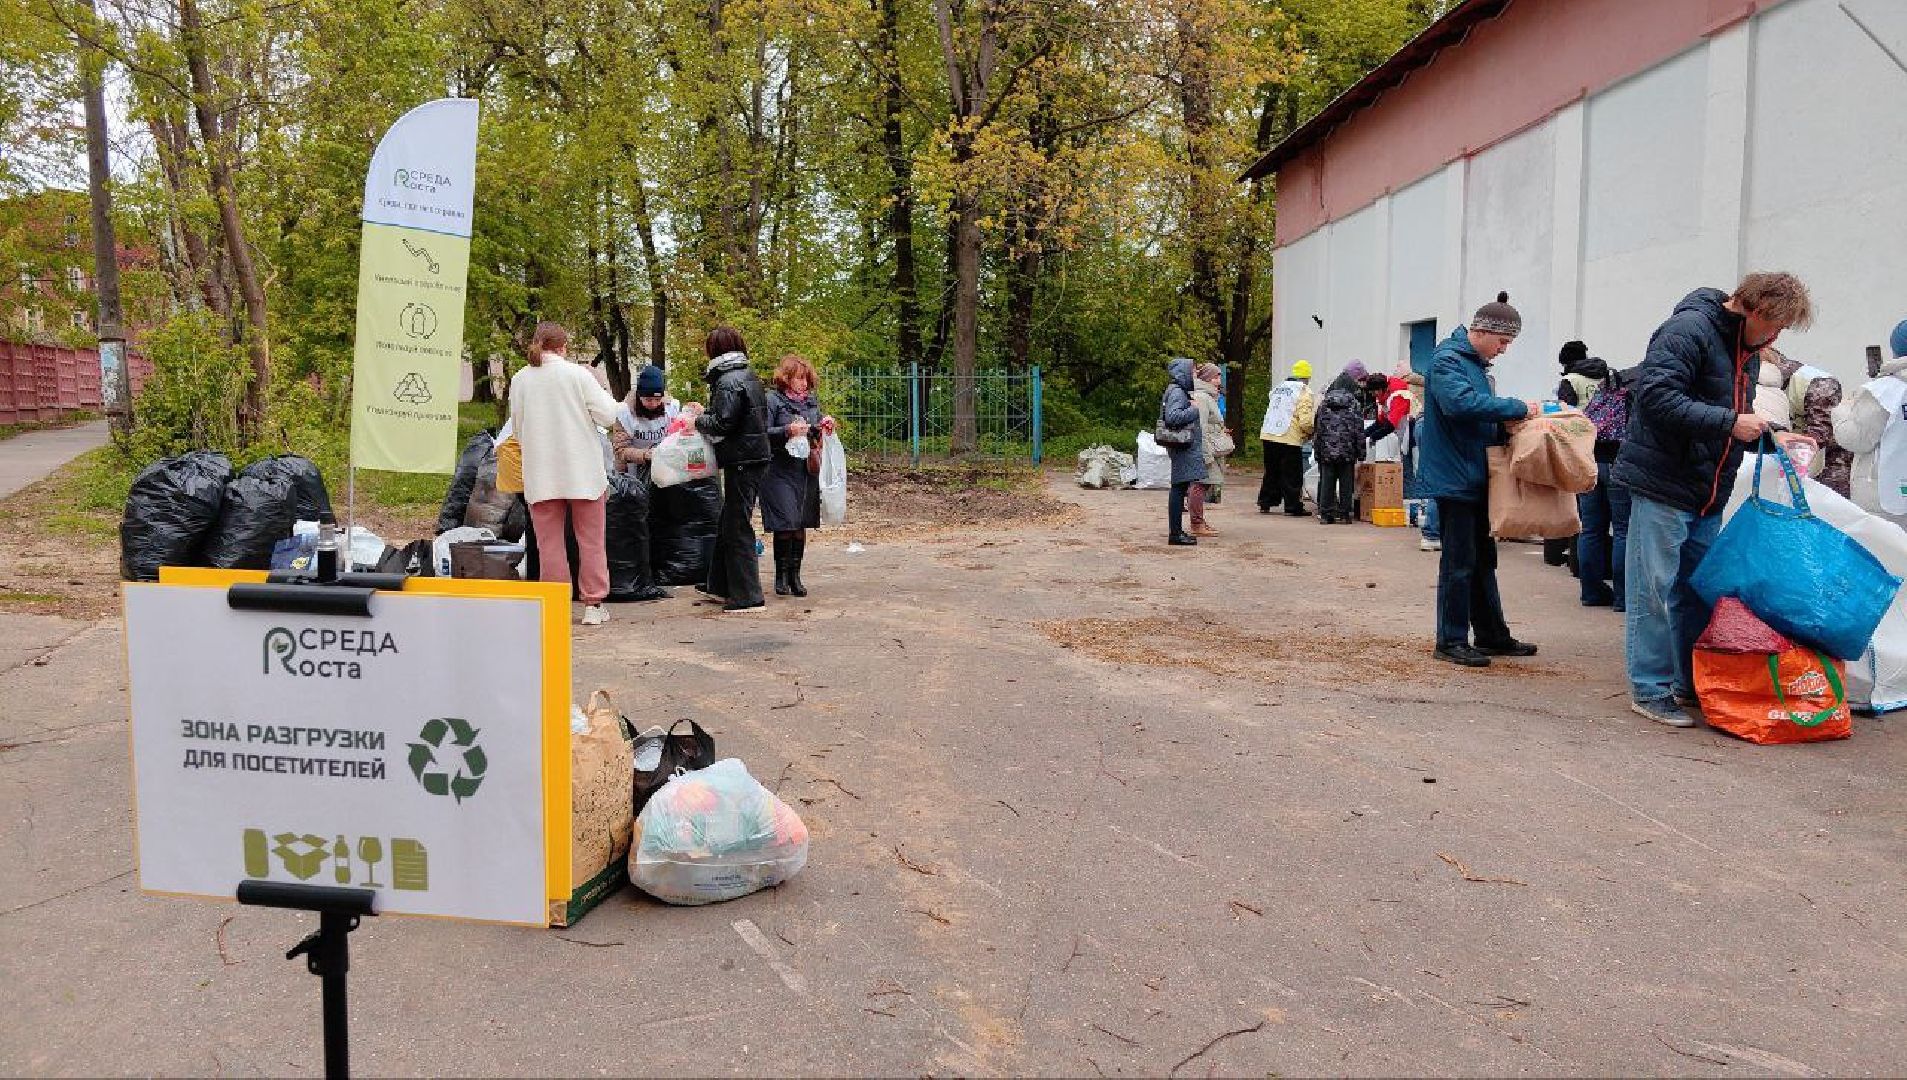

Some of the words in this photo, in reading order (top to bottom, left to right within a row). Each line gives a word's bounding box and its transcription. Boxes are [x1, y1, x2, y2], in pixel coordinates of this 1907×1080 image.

[410, 170, 452, 187] СРЕДА
[299, 627, 400, 657] СРЕДА
[180, 718, 241, 742] ЗОНА
[247, 724, 386, 751] РАЗГРУЗКИ
[183, 749, 227, 769] ДЛЯ
[231, 752, 386, 780] ПОСЕТИТЕЛЕЙ
